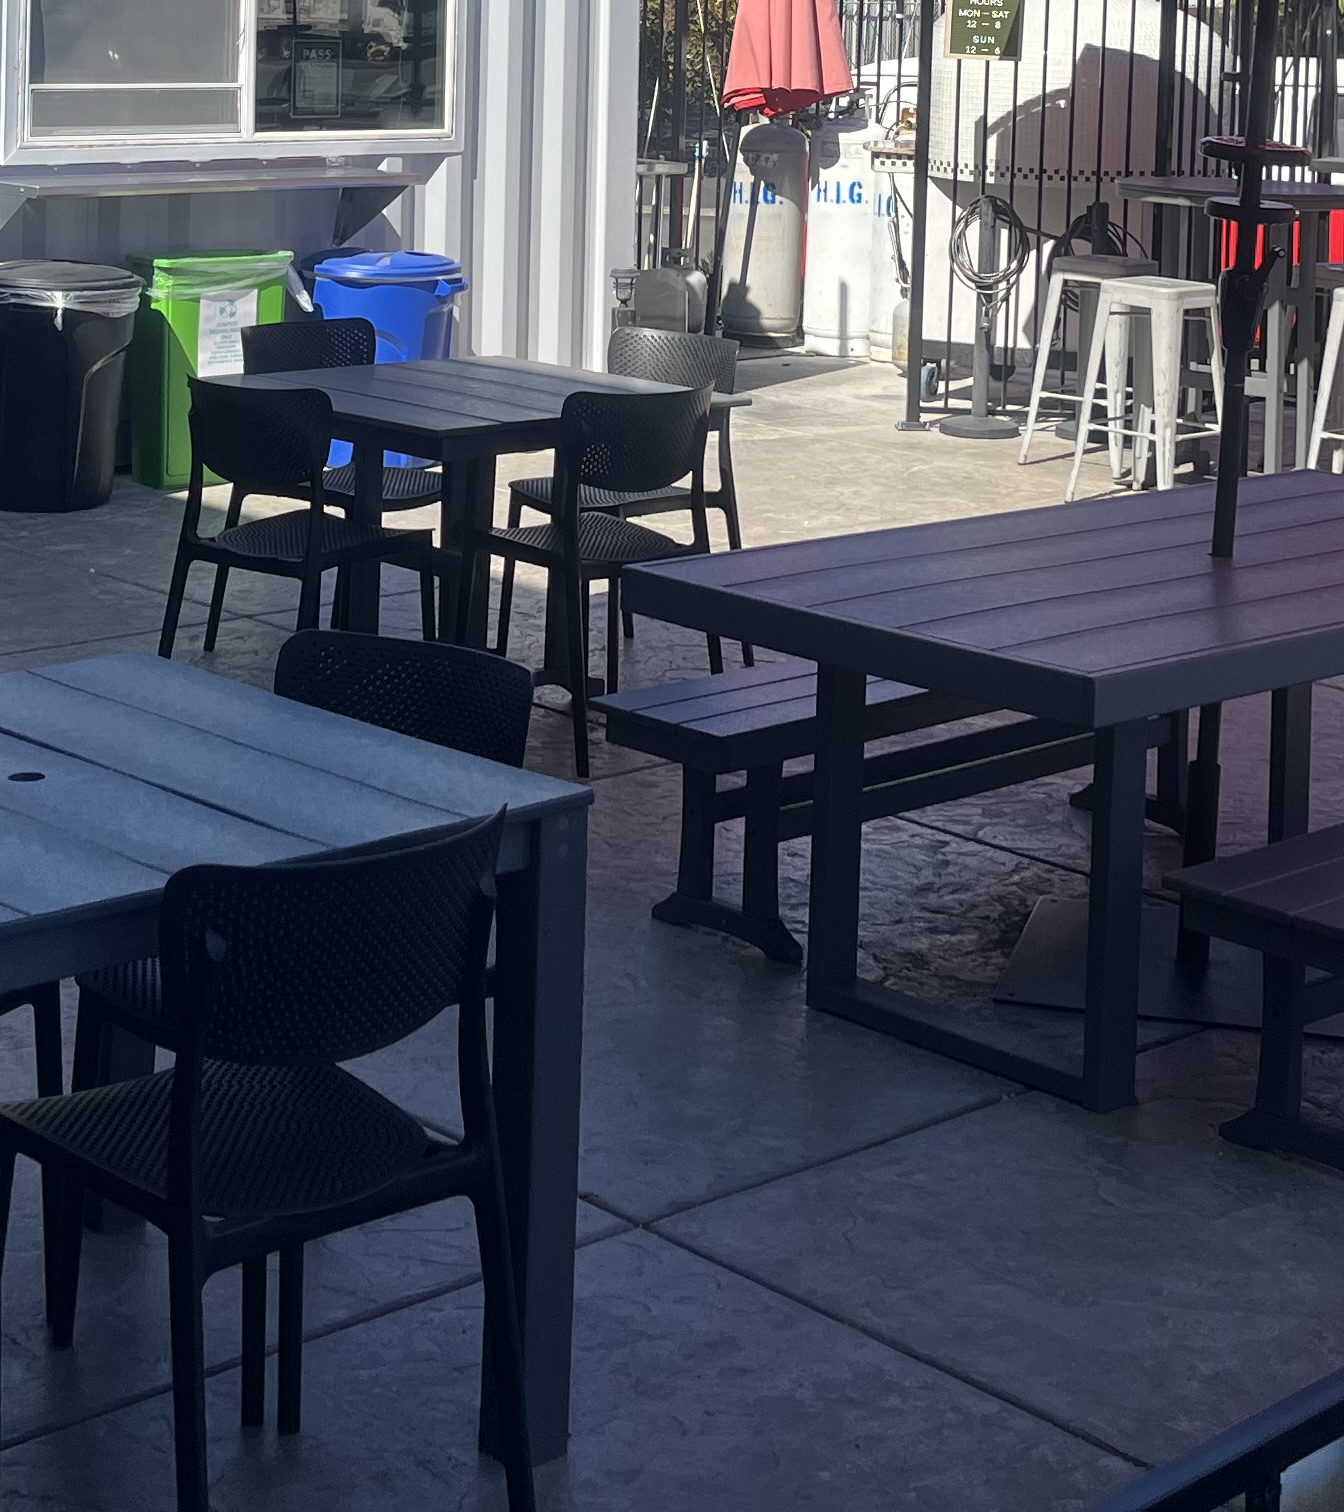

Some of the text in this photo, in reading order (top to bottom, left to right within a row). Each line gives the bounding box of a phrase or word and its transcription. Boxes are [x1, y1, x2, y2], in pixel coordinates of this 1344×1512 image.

[967, 20, 977, 28] 12
[995, 21, 1001, 29] 8
[973, 35, 994, 43] SUN
[303, 49, 331, 59] PASS
[966, 46, 976, 54] 12
[817, 180, 868, 204] H.I.G.
